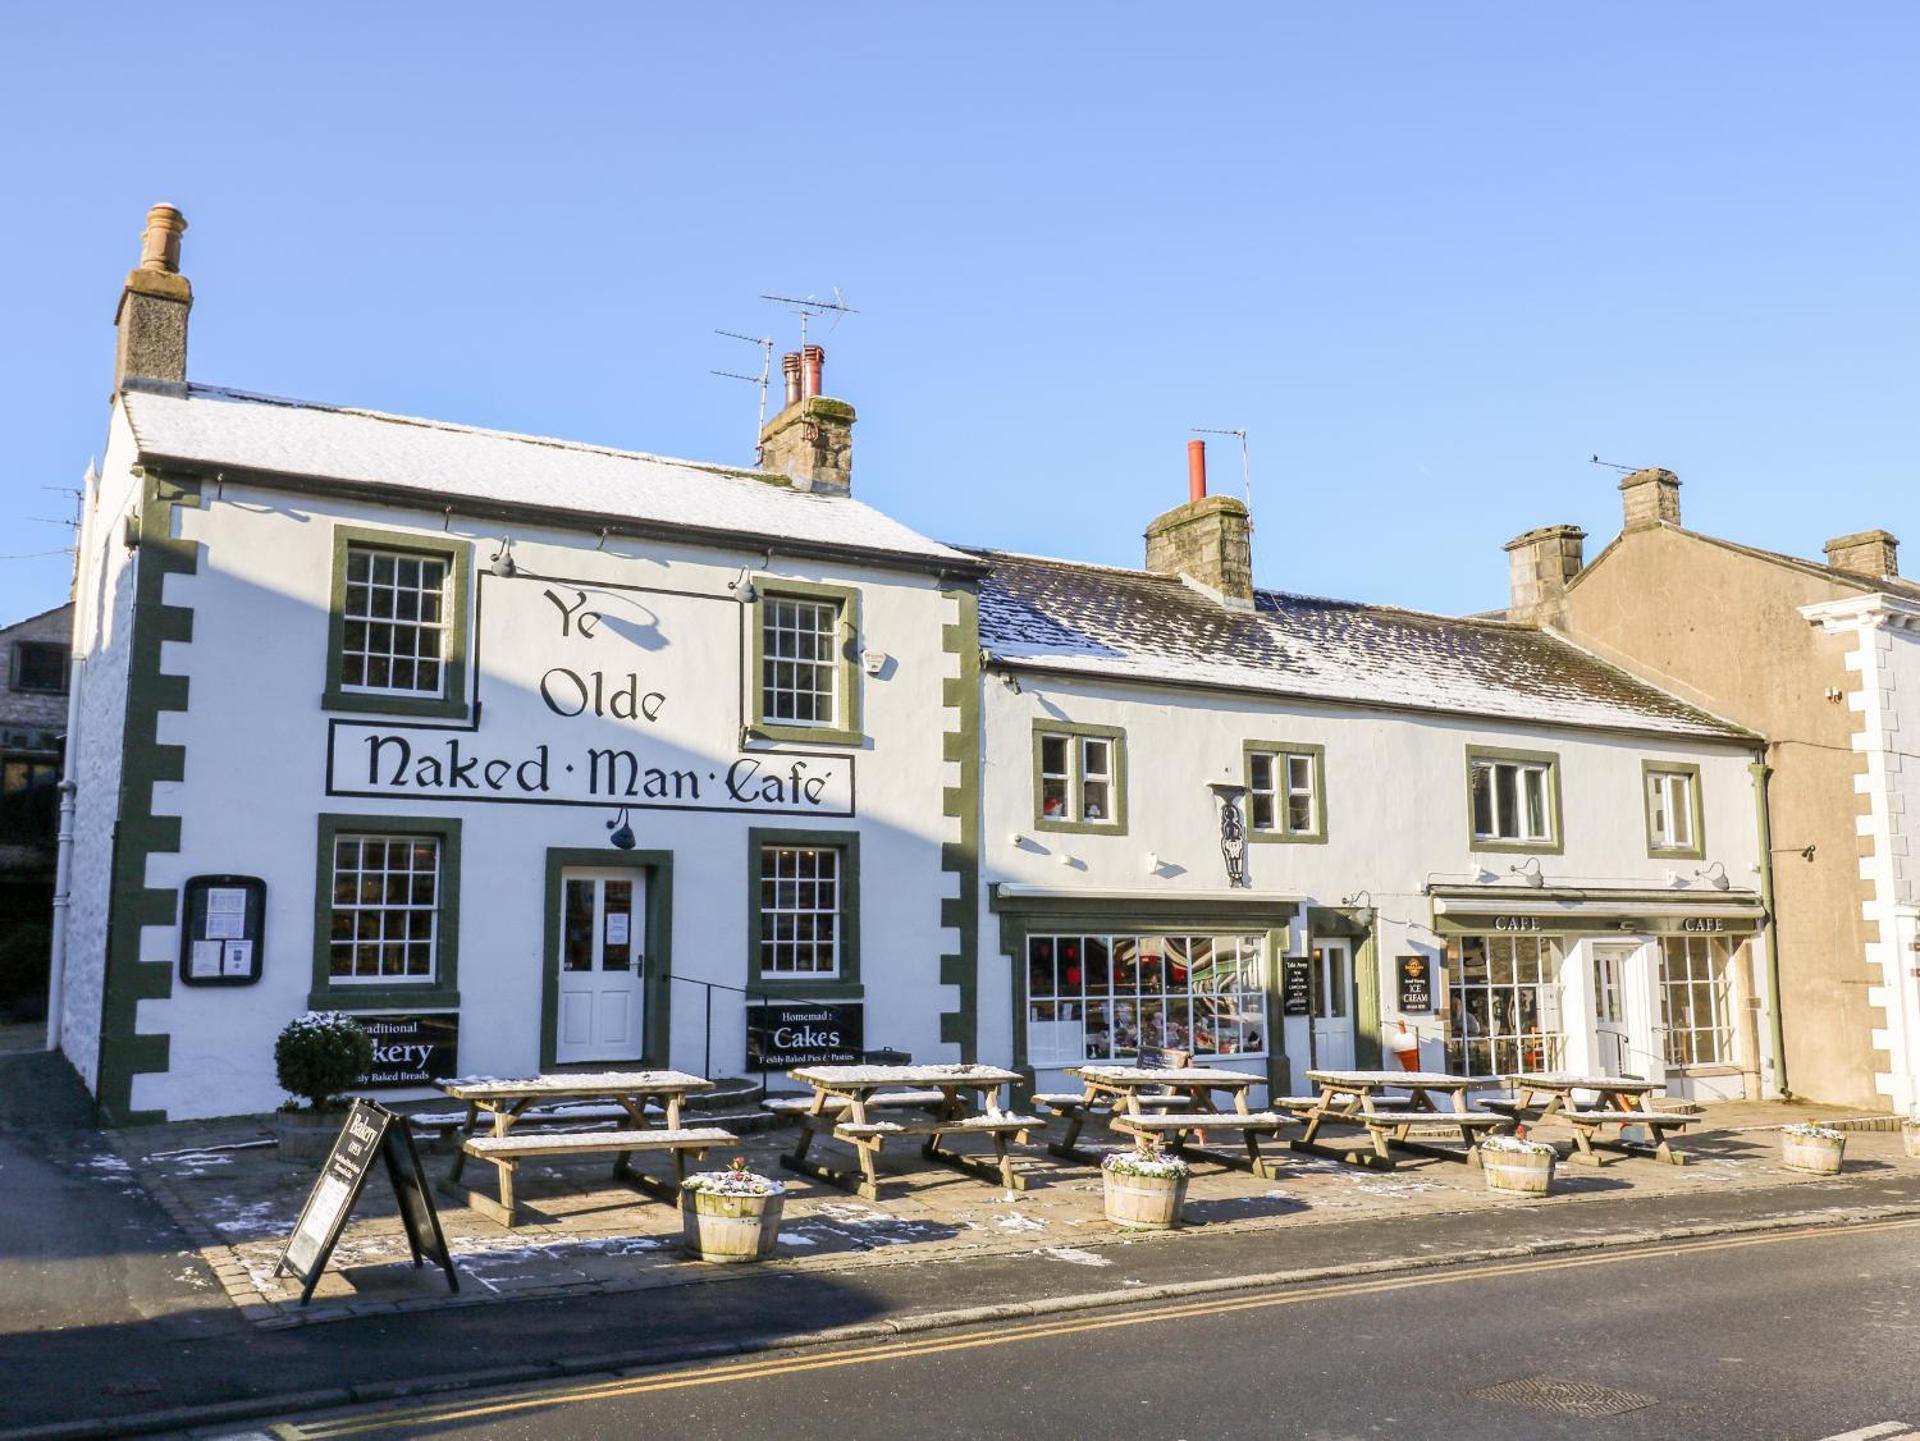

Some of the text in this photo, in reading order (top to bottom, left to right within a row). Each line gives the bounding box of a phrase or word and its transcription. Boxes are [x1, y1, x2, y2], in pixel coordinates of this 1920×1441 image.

[543, 588, 601, 640] Ye
[540, 667, 667, 723] Olde
[364, 733, 834, 806] Naked Man Café
[1495, 916, 1540, 931] CAFE
[1685, 918, 1724, 932] CAFE
[1403, 993, 1428, 1003] CREAM
[362, 1021, 418, 1034] aditional
[774, 1025, 841, 1048] Cakes
[371, 1038, 434, 1069] kery
[759, 1055, 783, 1066] Feshly
[371, 1071, 398, 1081] Baked
[401, 1070, 430, 1080] Breads
[349, 1113, 378, 1151] Bakery
